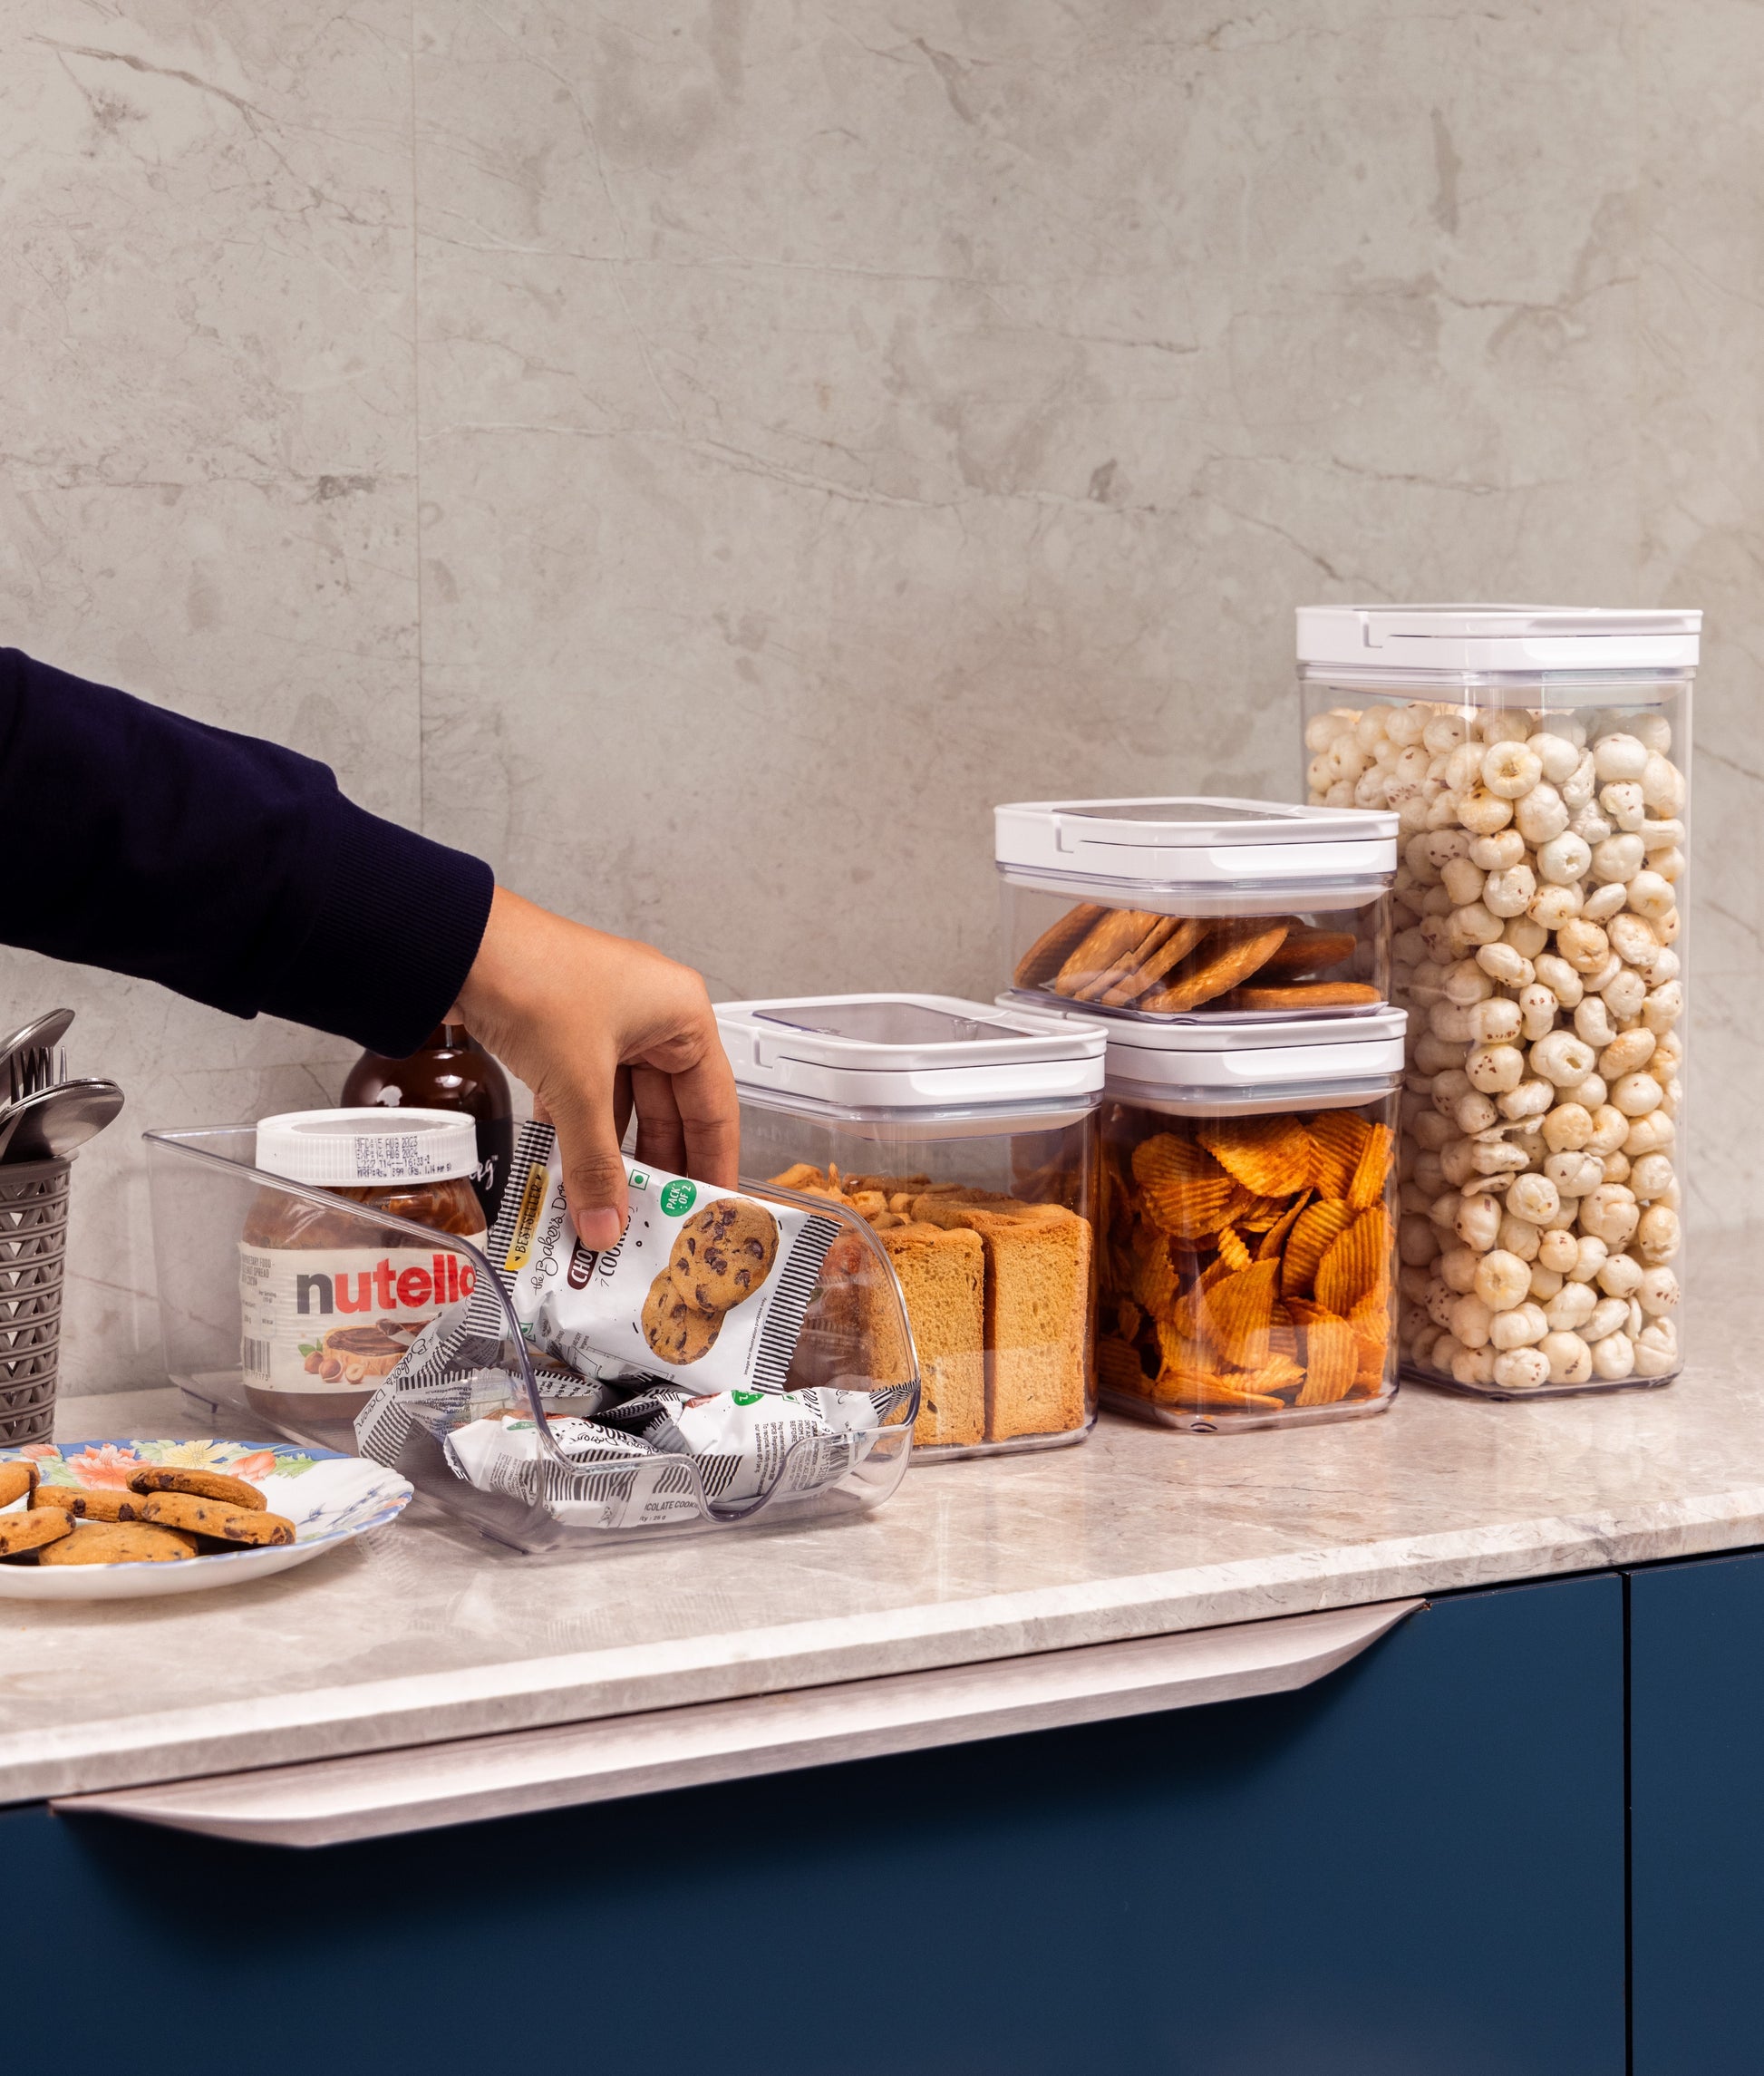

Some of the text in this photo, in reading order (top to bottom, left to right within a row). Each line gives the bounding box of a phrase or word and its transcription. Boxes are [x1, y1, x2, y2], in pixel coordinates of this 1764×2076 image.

[666, 1187, 681, 1210] PACK
[678, 1192, 689, 1205] OF
[515, 1185, 542, 1253] BESTSELLER
[536, 1214, 565, 1276] Baker's
[530, 1274, 544, 1295] the
[790, 1420, 798, 1443] BEFORE
[797, 1420, 805, 1434] FROM
